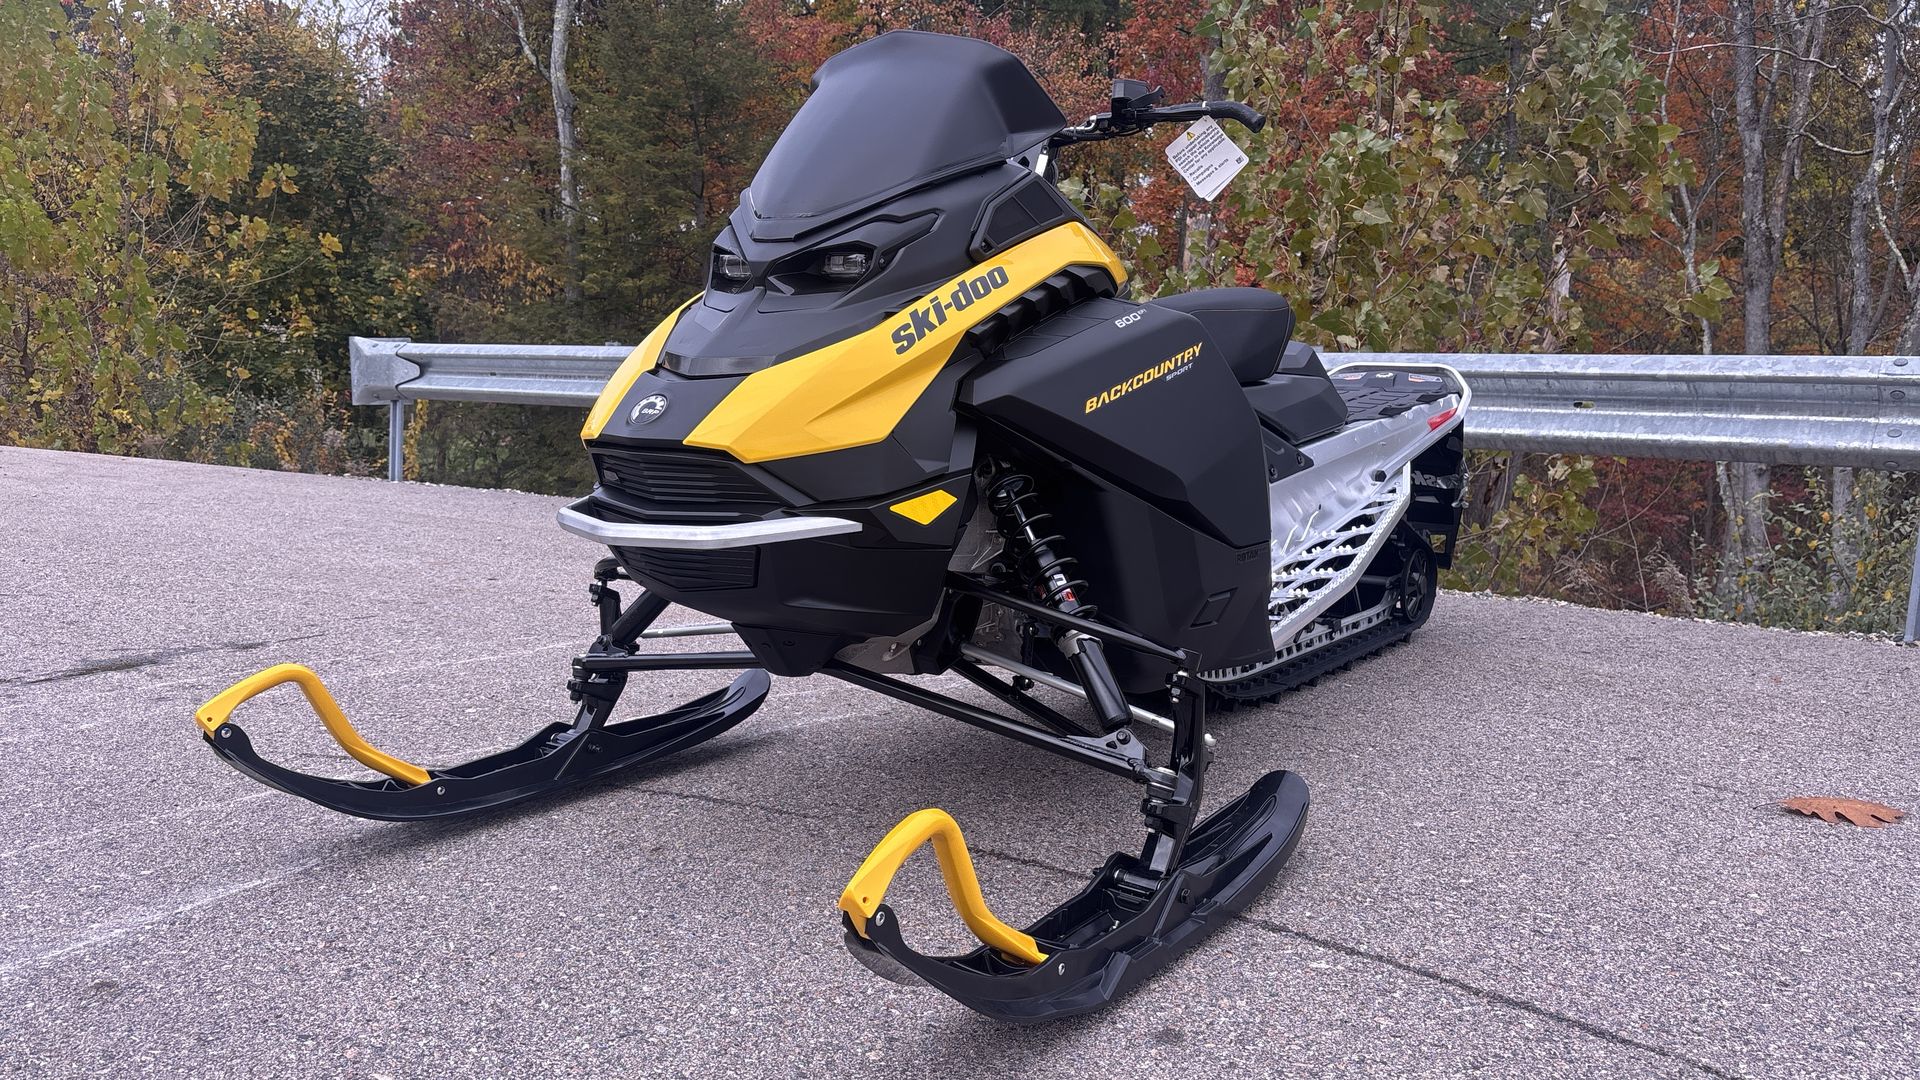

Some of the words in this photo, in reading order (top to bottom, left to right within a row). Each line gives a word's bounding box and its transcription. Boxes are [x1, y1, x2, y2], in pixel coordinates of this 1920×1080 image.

[891, 266, 1009, 355] ski-doo
[1115, 312, 1141, 328] 600
[1085, 342, 1203, 414] BACKCOUNTRY
[1166, 362, 1193, 381] SPORT
